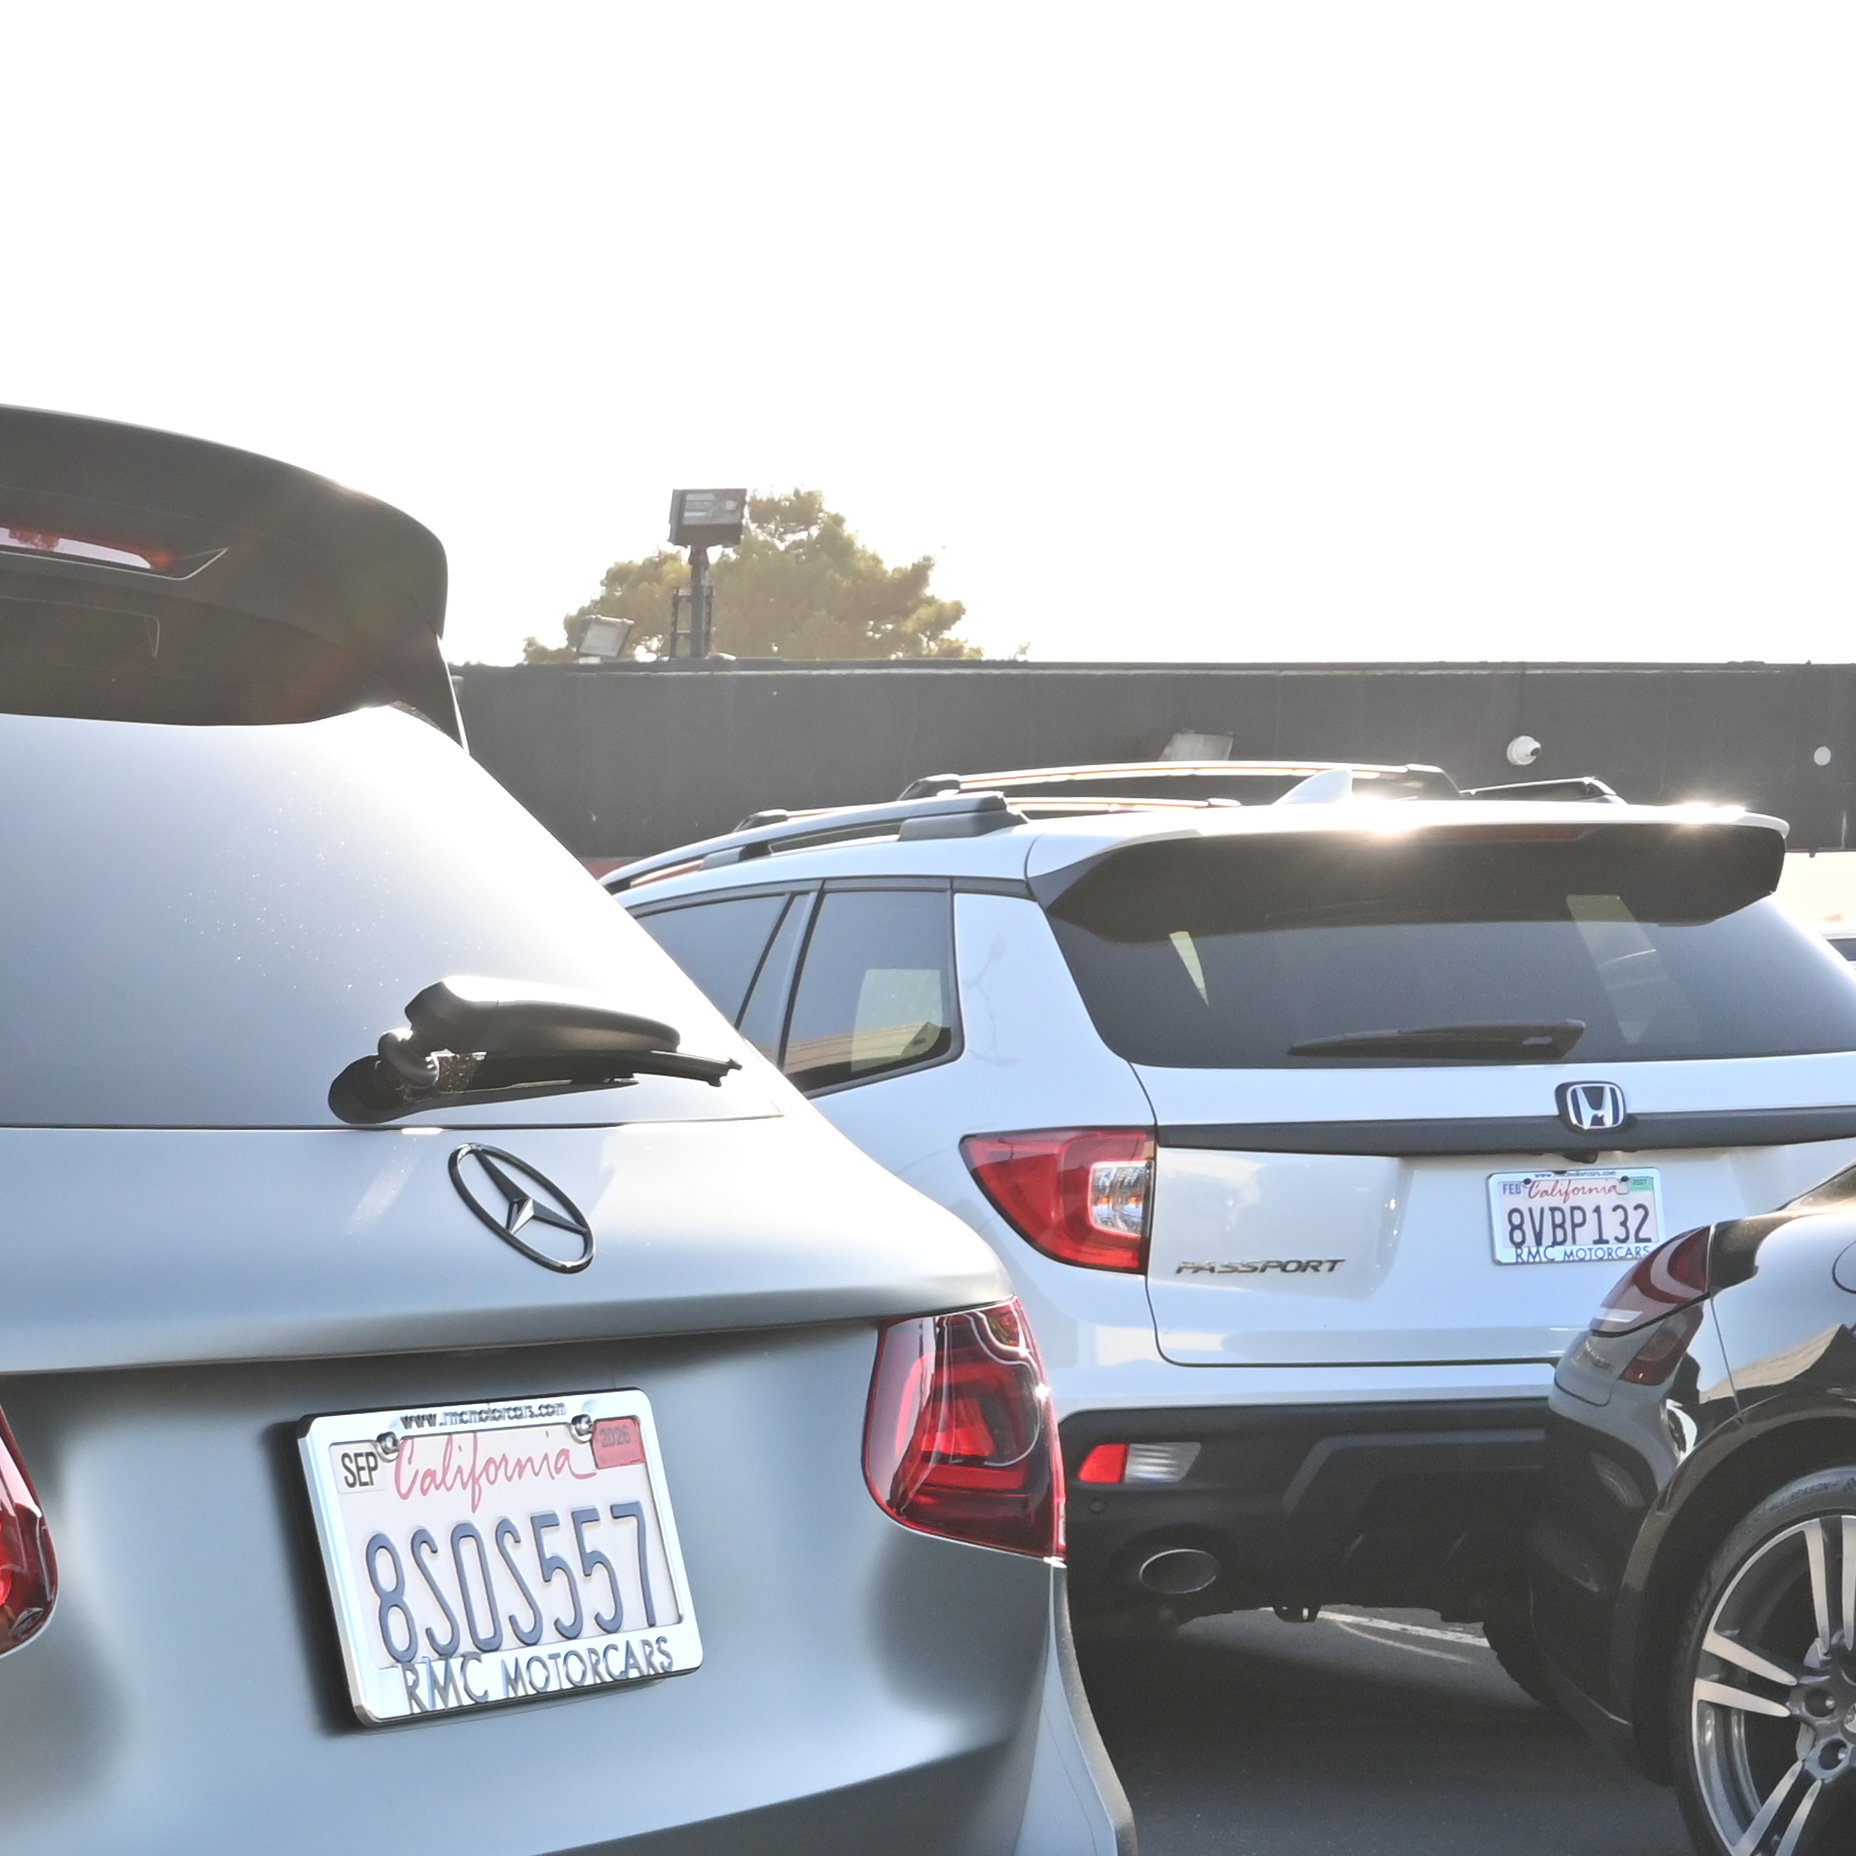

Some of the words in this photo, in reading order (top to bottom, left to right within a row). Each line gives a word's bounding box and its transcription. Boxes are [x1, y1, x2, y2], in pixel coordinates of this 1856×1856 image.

[1502, 1183, 1522, 1196] FEB
[1527, 1179, 1630, 1204] California
[1506, 1203, 1653, 1247] 8VBP132
[1174, 1258, 1347, 1275] PASSPORT
[1514, 1245, 1556, 1263] RMC
[1562, 1244, 1651, 1262] MOTORCARS
[340, 1450, 379, 1489] SEP
[393, 1431, 598, 1515] California
[364, 1500, 658, 1664] 8SOS557
[401, 1651, 490, 1714] RMC
[500, 1635, 675, 1699] MOTORCARS
